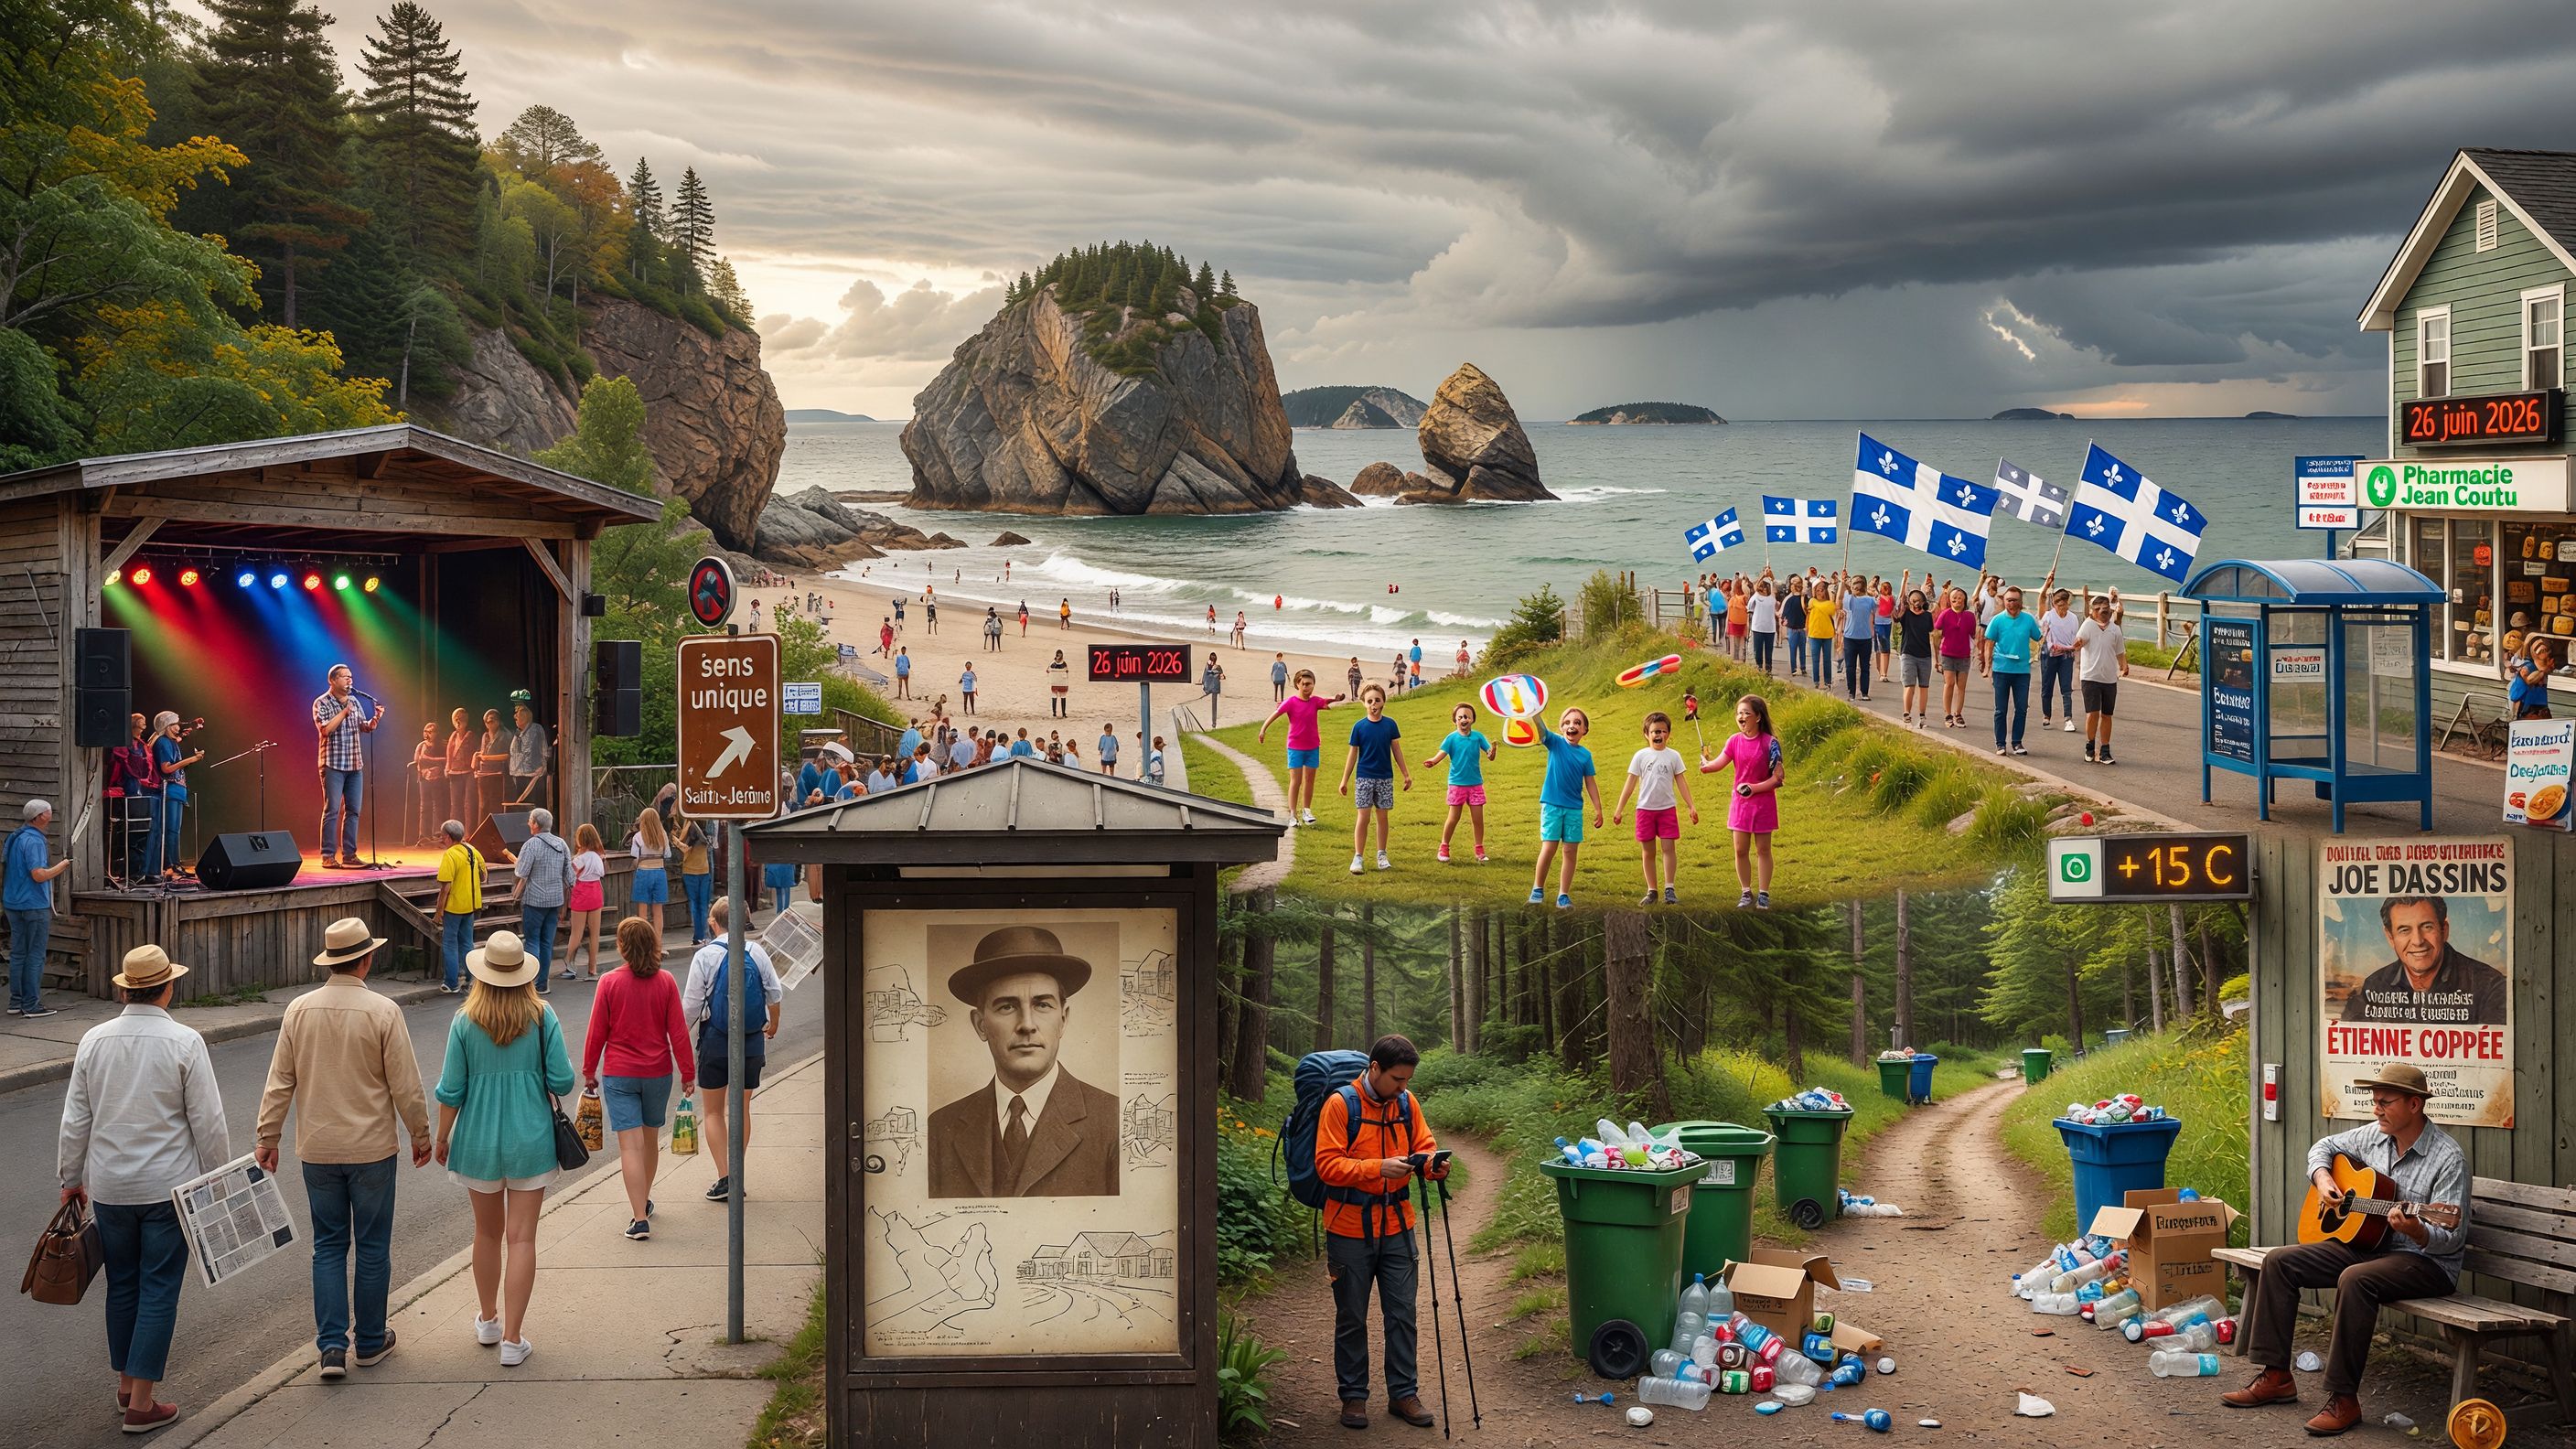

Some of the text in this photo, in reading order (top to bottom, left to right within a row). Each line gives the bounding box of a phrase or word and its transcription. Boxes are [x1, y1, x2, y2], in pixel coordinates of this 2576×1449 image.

[2410, 398, 2540, 442] 26 juin 2026
[2403, 464, 2513, 485] Pharmacie
[2401, 486, 2517, 507] Jean Coutu
[701, 654, 754, 678] sens
[1093, 650, 1111, 673] 26
[1147, 650, 1182, 674] 2026
[691, 682, 767, 714] unique
[2118, 844, 2233, 886] +15 C
[2328, 863, 2507, 895] JOE DASSINS
[2327, 1020, 2504, 1060] ÉTIENNE COPPÉE
